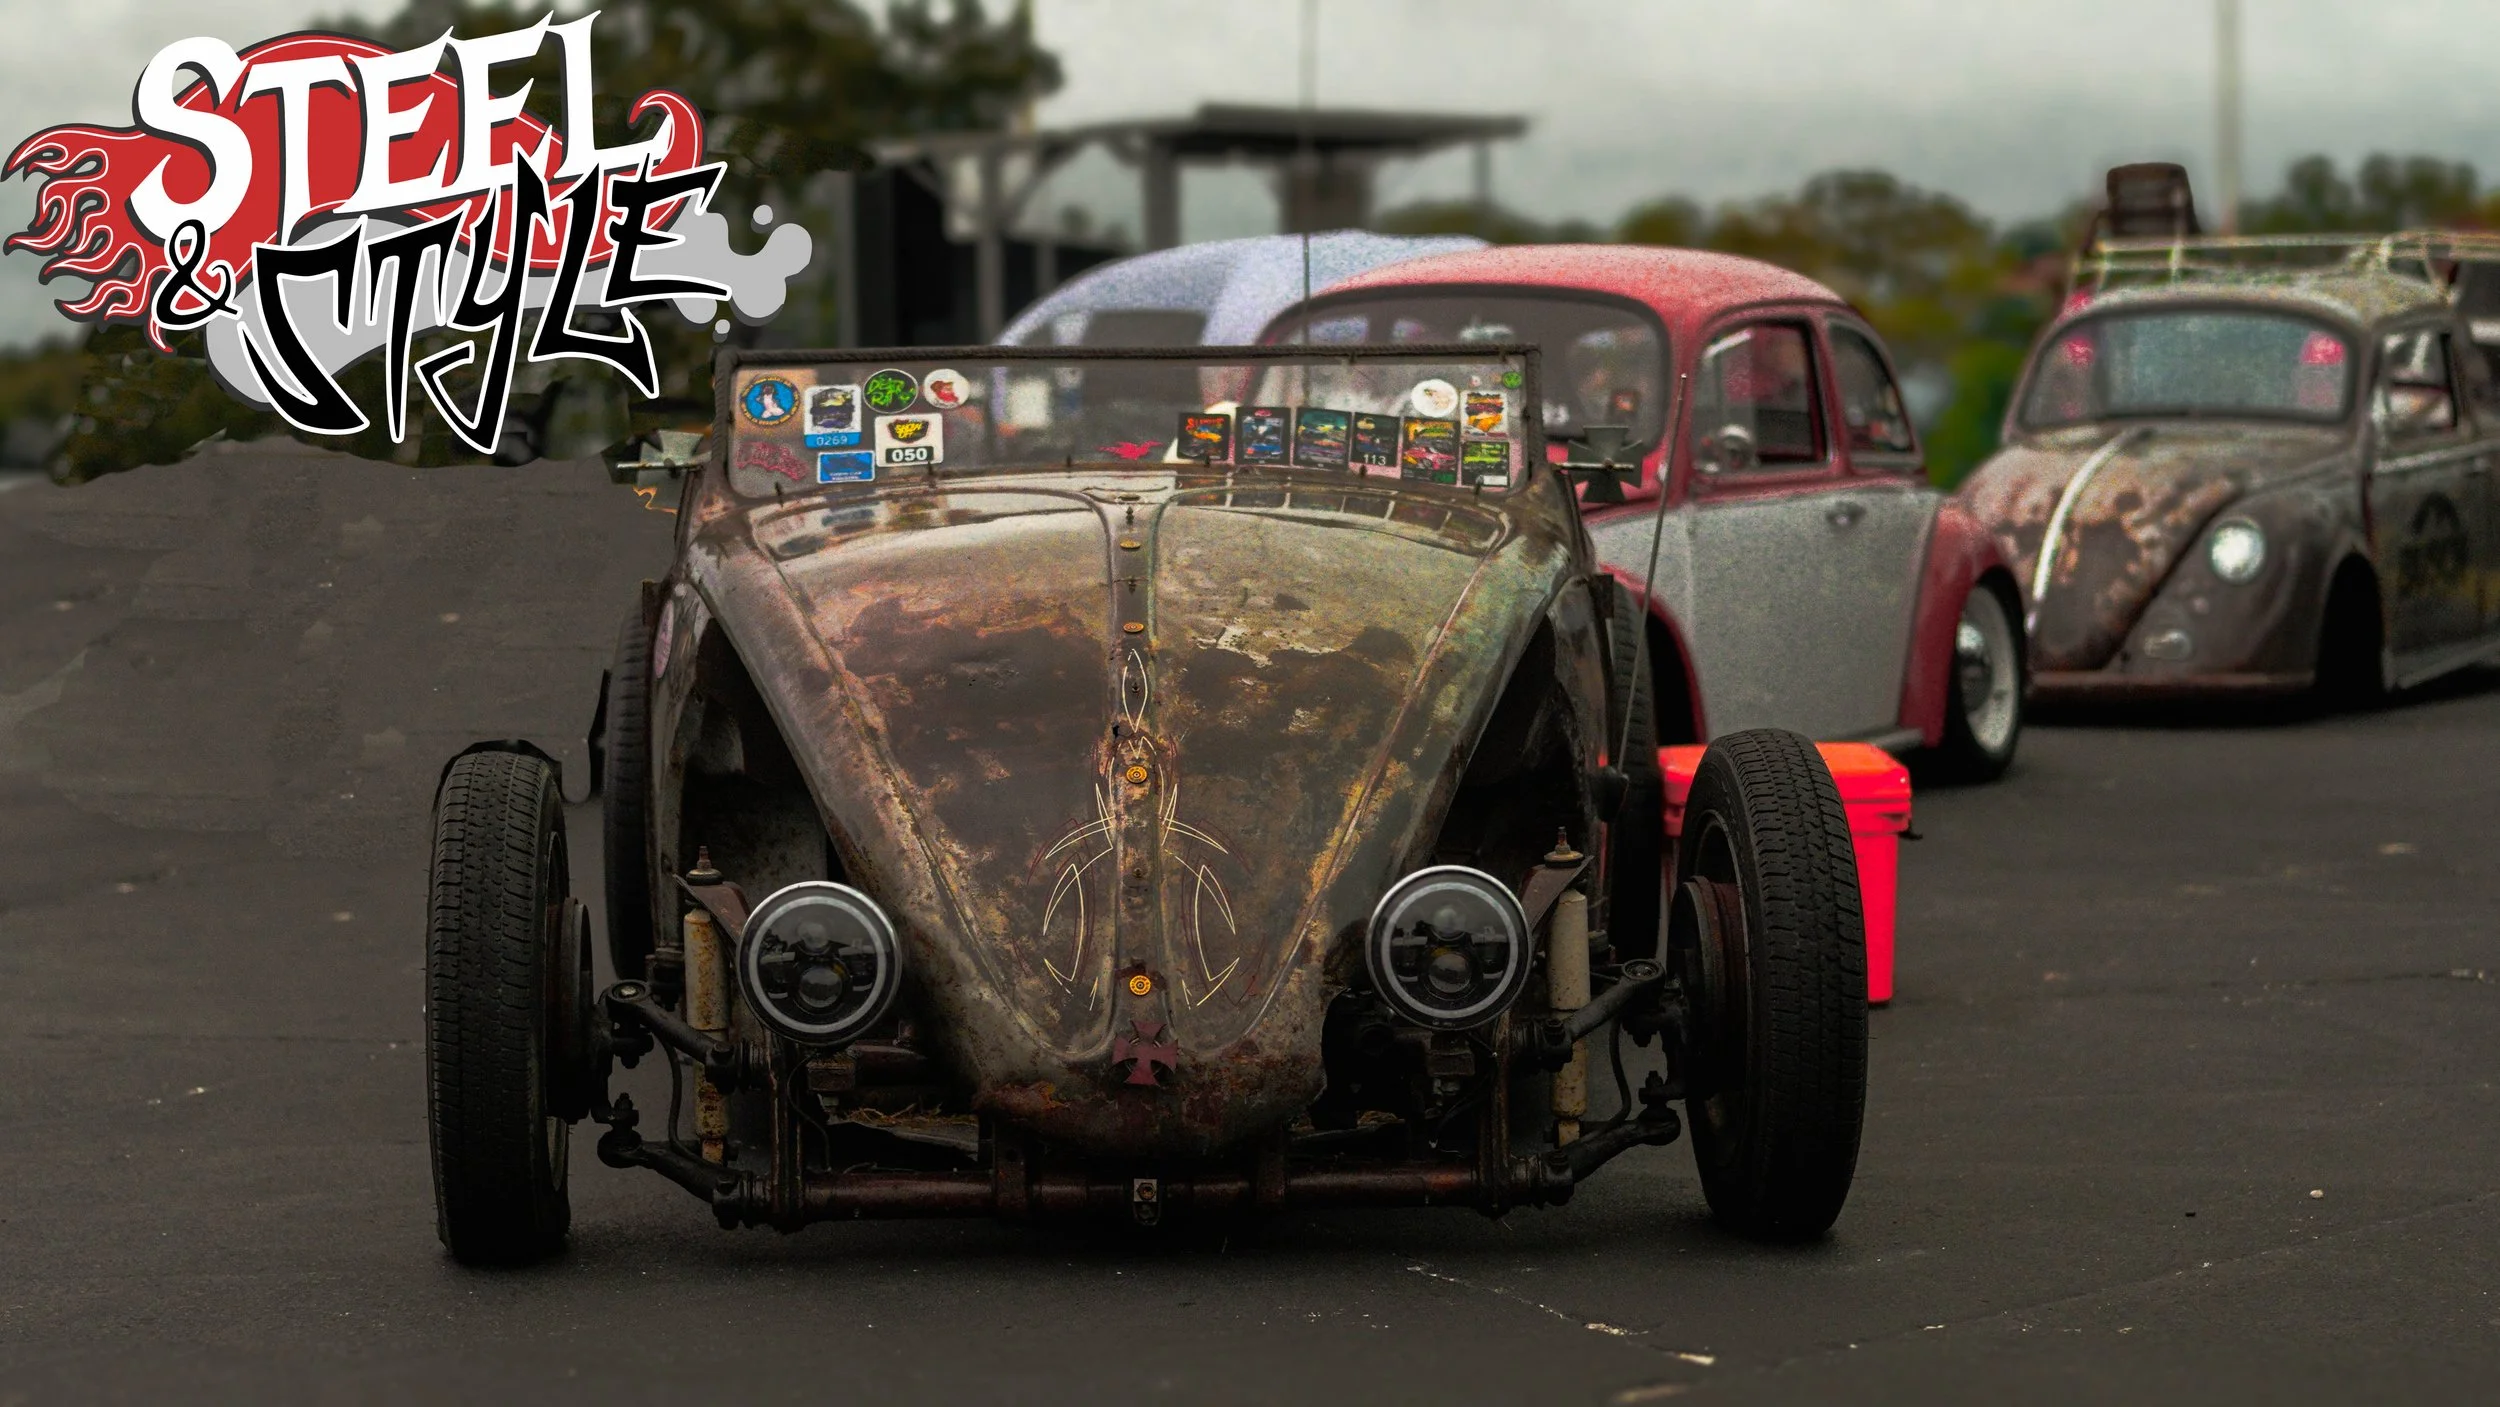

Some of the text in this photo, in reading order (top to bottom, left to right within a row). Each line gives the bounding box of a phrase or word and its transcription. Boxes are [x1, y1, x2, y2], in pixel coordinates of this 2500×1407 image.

[816, 435, 848, 447] 0269
[892, 448, 928, 462] 050
[1363, 454, 1386, 466] 113
